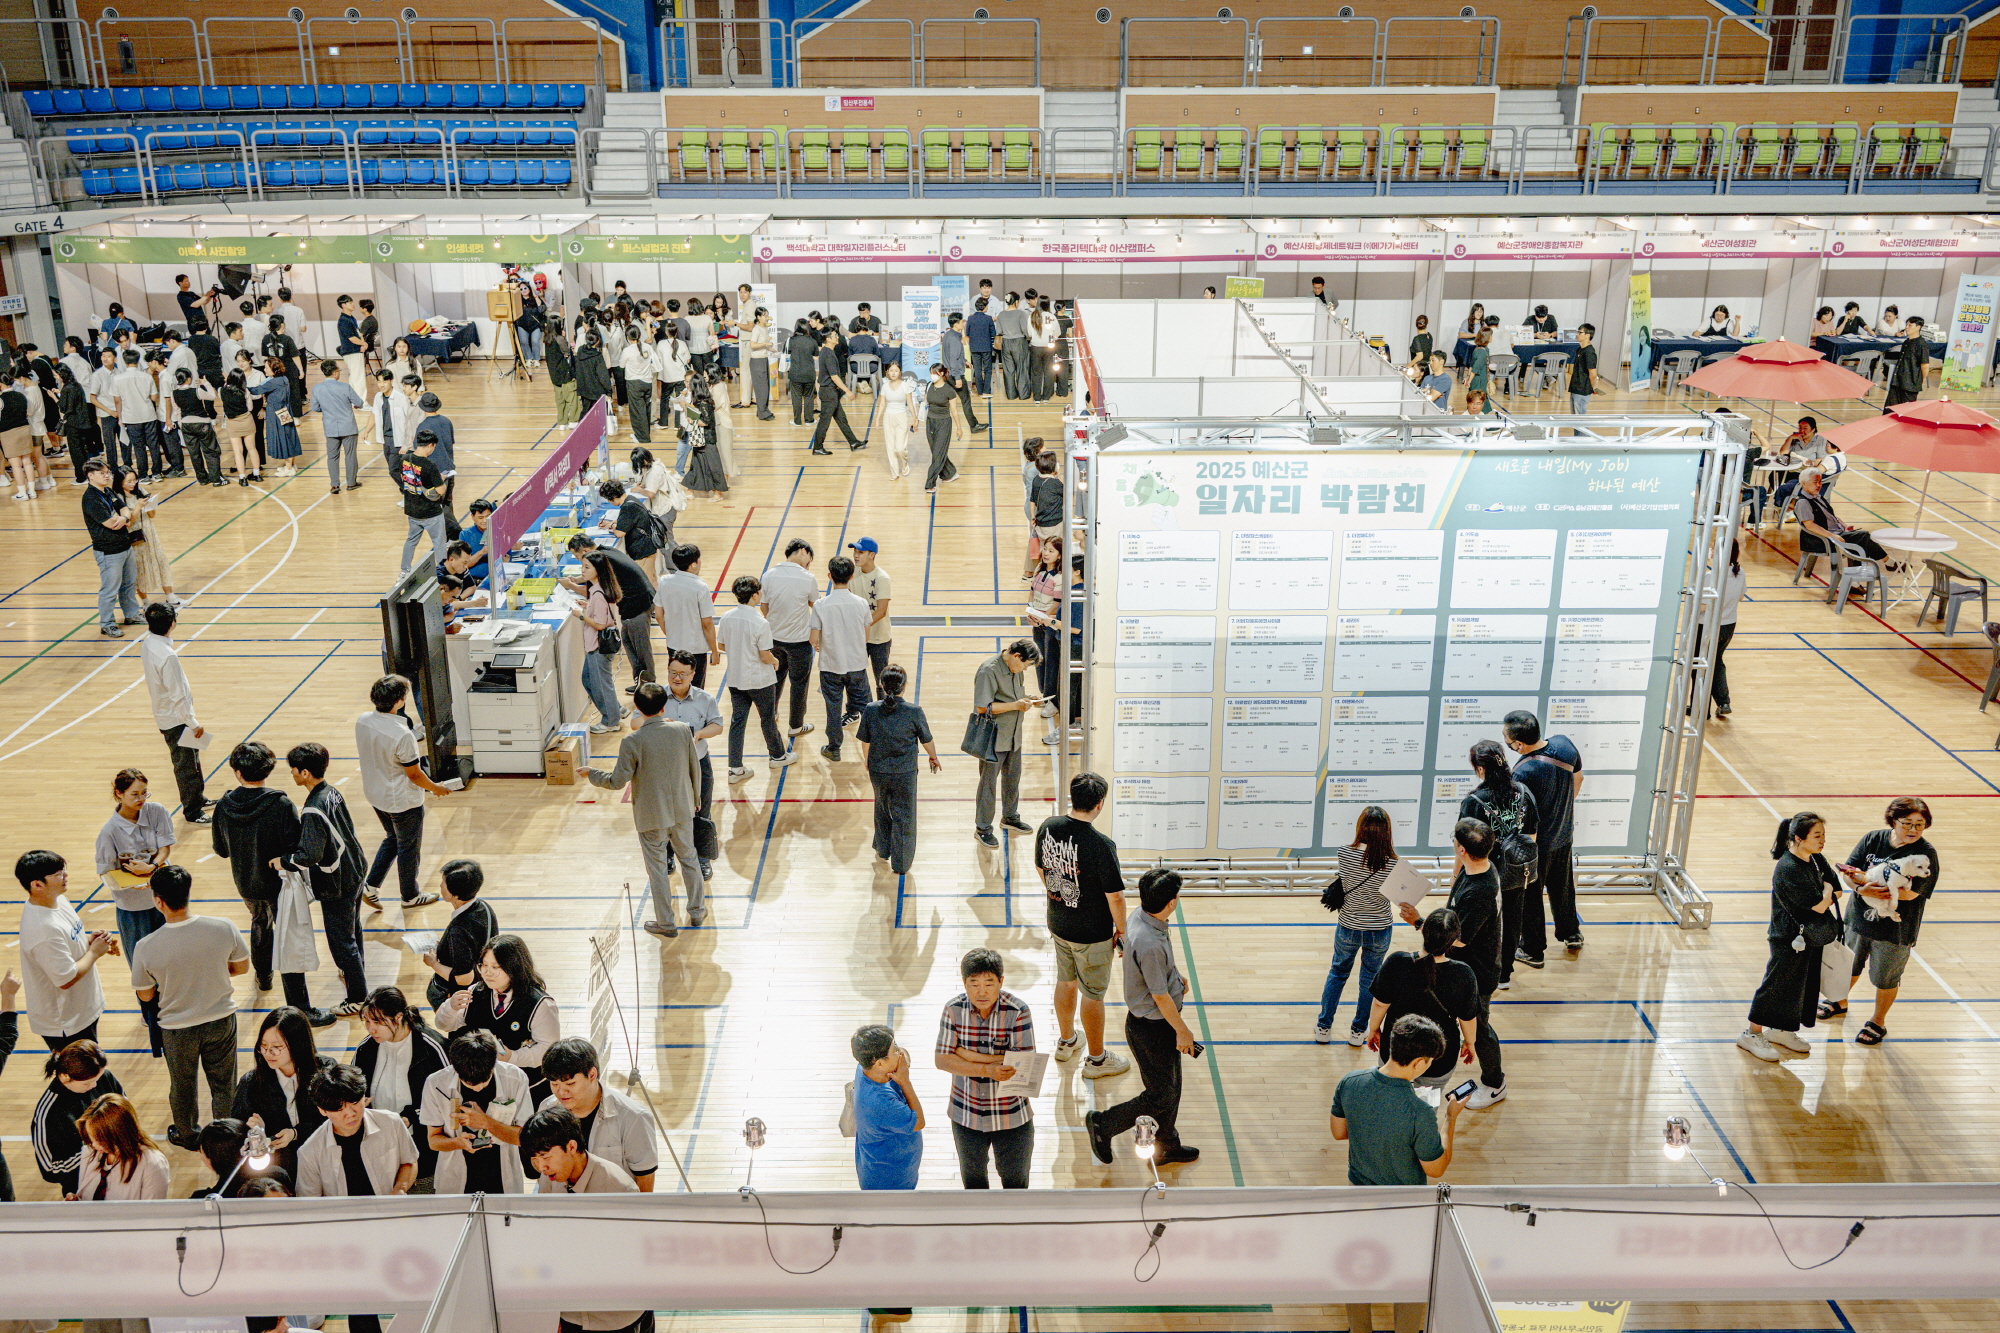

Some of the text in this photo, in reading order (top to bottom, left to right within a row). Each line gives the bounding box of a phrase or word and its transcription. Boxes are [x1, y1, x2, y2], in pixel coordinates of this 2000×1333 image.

[14, 215, 64, 232] GATE 4
[446, 243, 484, 254] 인생네컷
[622, 243, 669, 254] 퍼스널컬러
[786, 243, 906, 252] 백석대학교 대학일자리플러스센터
[1042, 243, 1155, 253] 한국폴리텍대학 아산캠퍼스
[1284, 242, 1362, 250] 예산사회경제네트워크
[1497, 241, 1583, 249] 예산군장애인종합복지관
[1701, 240, 1756, 248] 예산군여성회관
[1880, 239, 1958, 247] 예산군여성단체협의회
[178, 246, 247, 257] 이력서 사진촬영
[1961, 304, 1991, 314] 양성평등
[1958, 313, 1990, 324] 문화 확산
[1960, 323, 1984, 333] 캠페인
[1196, 460, 1309, 479] 2025 예산군
[1495, 456, 1630, 475] 새로운 내일(My Job)
[544, 451, 571, 495] 이력서 작성대
[1587, 477, 1661, 493] 하나된 예산
[1196, 483, 1426, 515] 일자리 박람회
[1506, 504, 1527, 512] 예산군
